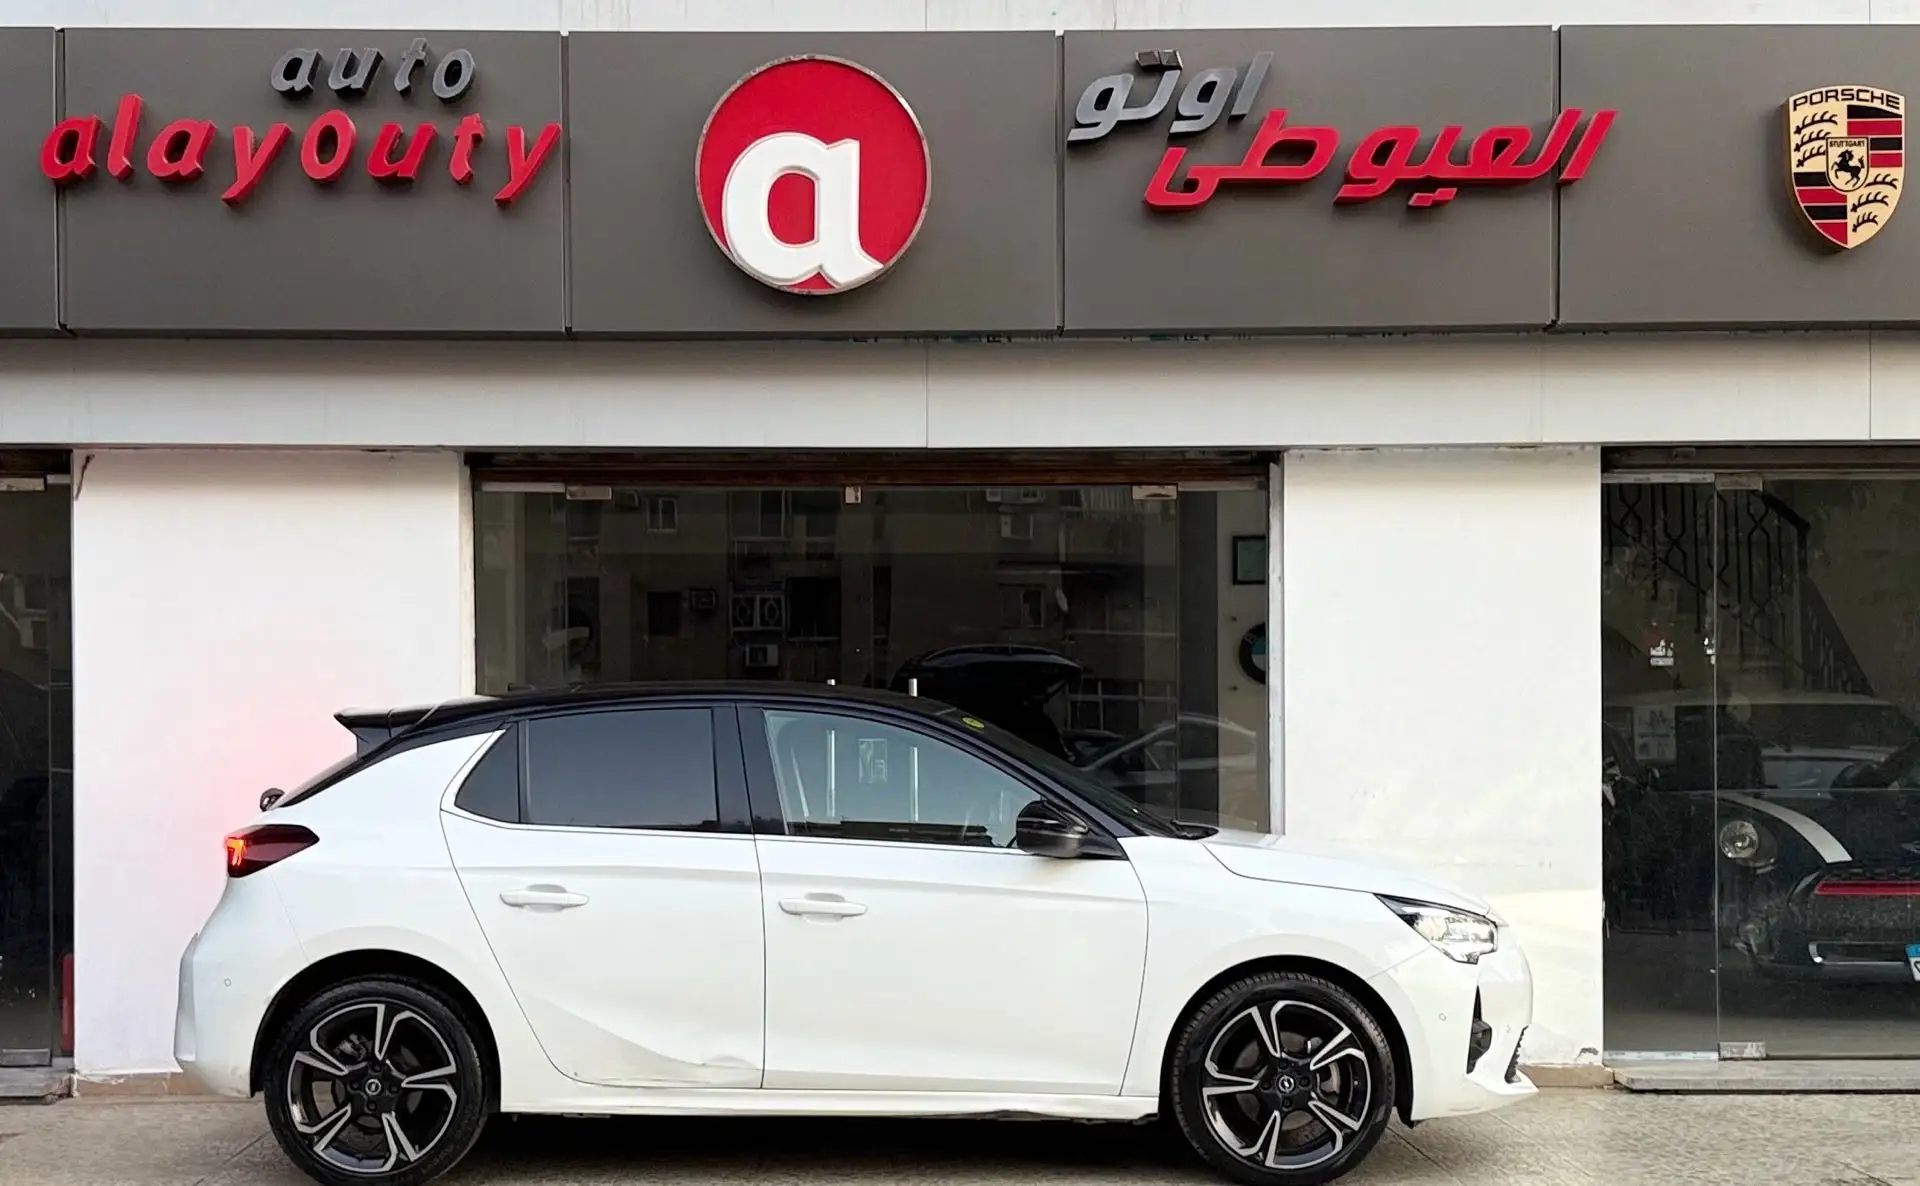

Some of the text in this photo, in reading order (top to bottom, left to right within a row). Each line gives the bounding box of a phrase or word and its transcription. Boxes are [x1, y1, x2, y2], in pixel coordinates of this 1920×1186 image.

[271, 37, 477, 101] auto
[1066, 48, 1274, 146] اوتو
[1793, 88, 1900, 112] PORSCHE
[1828, 139, 1866, 148] STUTTGART
[721, 131, 884, 289] a
